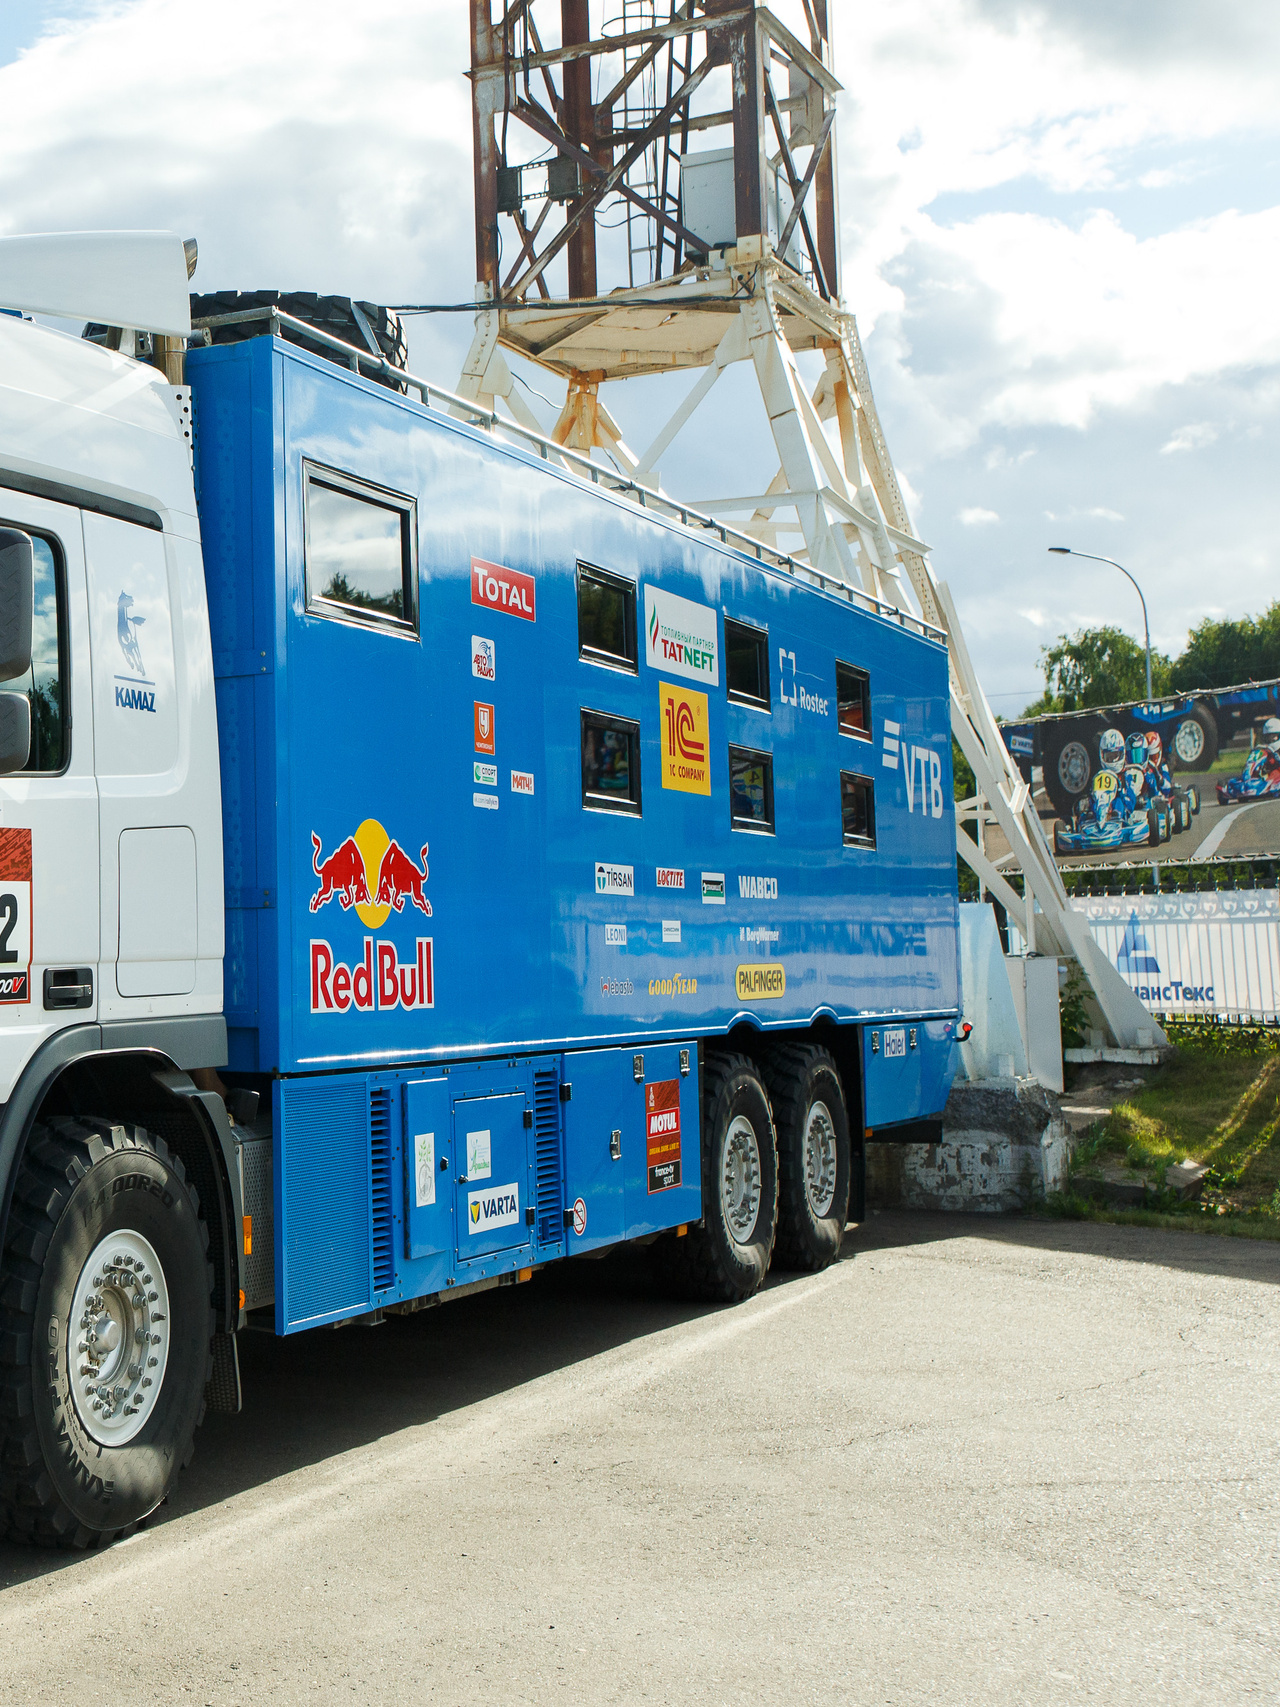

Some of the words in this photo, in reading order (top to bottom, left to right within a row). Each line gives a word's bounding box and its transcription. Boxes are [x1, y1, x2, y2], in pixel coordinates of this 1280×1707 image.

[661, 638, 715, 672] TATNEFT
[114, 686, 157, 713] KAMAZ
[799, 686, 829, 717] Rostec
[481, 767, 496, 777] СПОРТ
[678, 765, 705, 782] COMPANY
[901, 741, 943, 819] VTB
[1098, 775, 1112, 789] 19
[657, 870, 683, 887] LOCTITE
[738, 875, 778, 900] WABCO
[606, 928, 626, 942] LEONI
[746, 926, 780, 945] BorgWarner
[311, 940, 372, 1010] Red
[378, 941, 433, 1007] Bull
[738, 969, 783, 994] PALFINGER
[600, 976, 634, 998] Webasto
[885, 1032, 905, 1056] Haier
[650, 1111, 677, 1134] MOTUL
[663, 1173, 674, 1187] sport
[482, 1194, 517, 1219] VARTA
